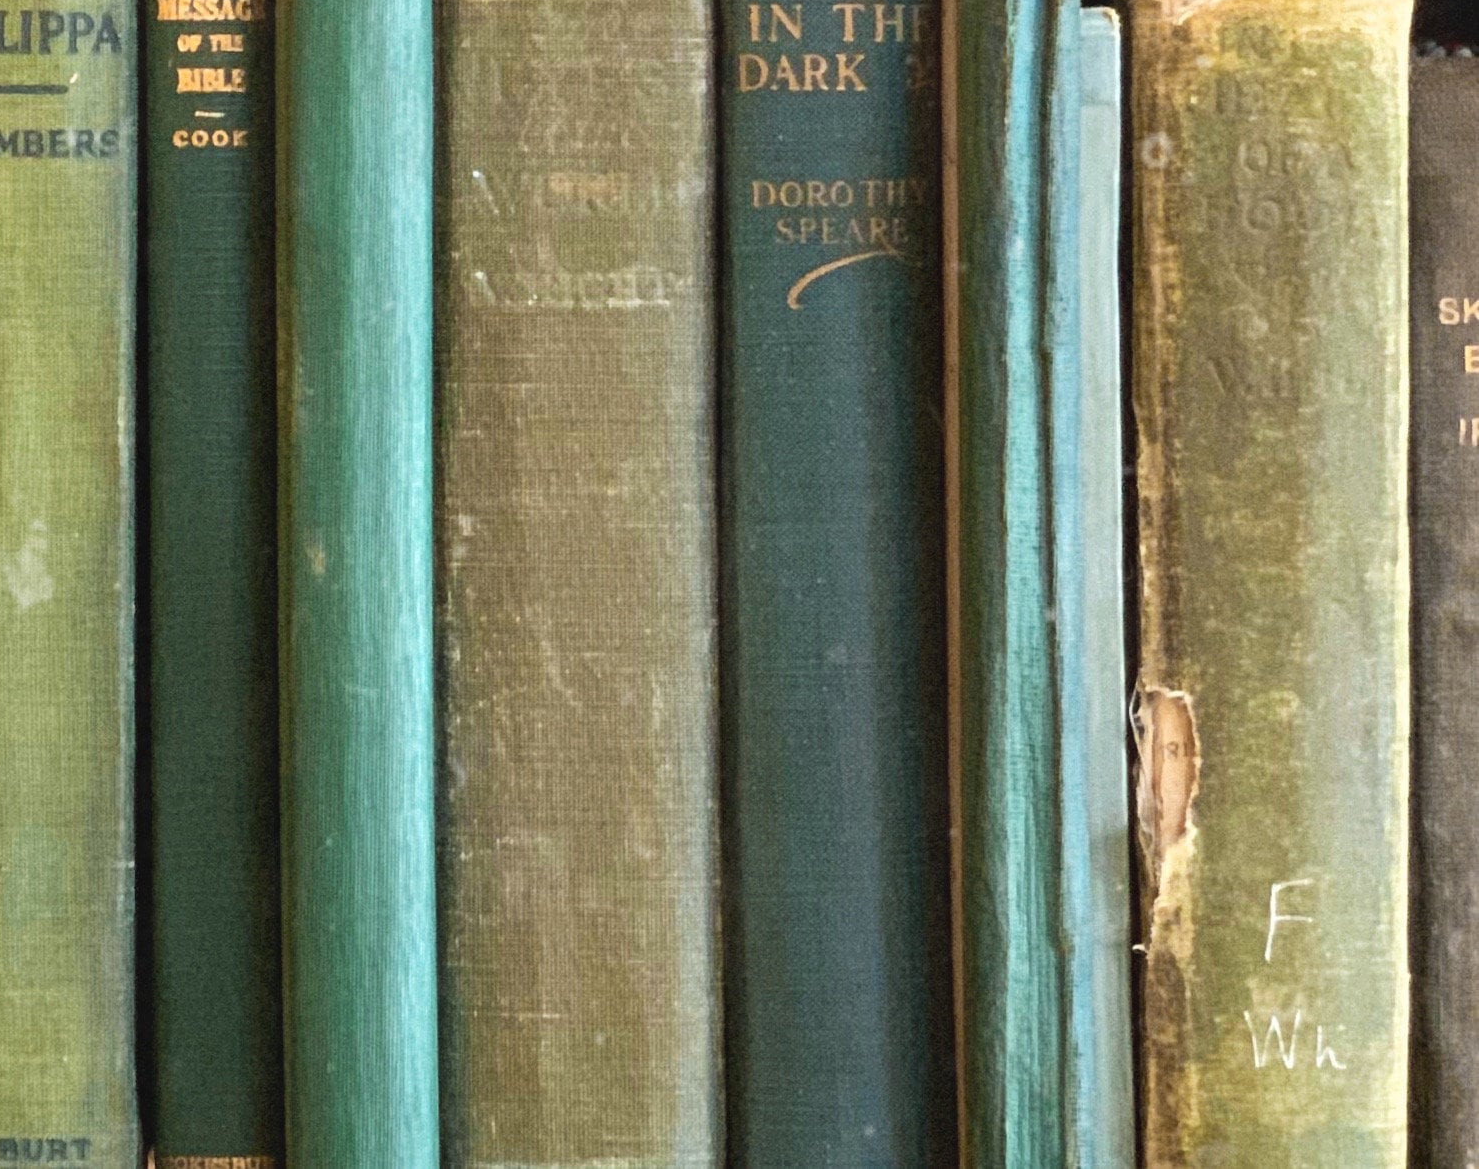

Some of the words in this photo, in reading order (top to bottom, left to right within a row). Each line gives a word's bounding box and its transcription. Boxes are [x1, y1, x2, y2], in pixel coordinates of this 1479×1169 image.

[747, 3, 804, 43] IN
[176, 34, 204, 53] OF
[208, 33, 244, 53] THE
[176, 67, 247, 93] BIBLE
[737, 52, 868, 91] DARK
[171, 130, 250, 149] COOK
